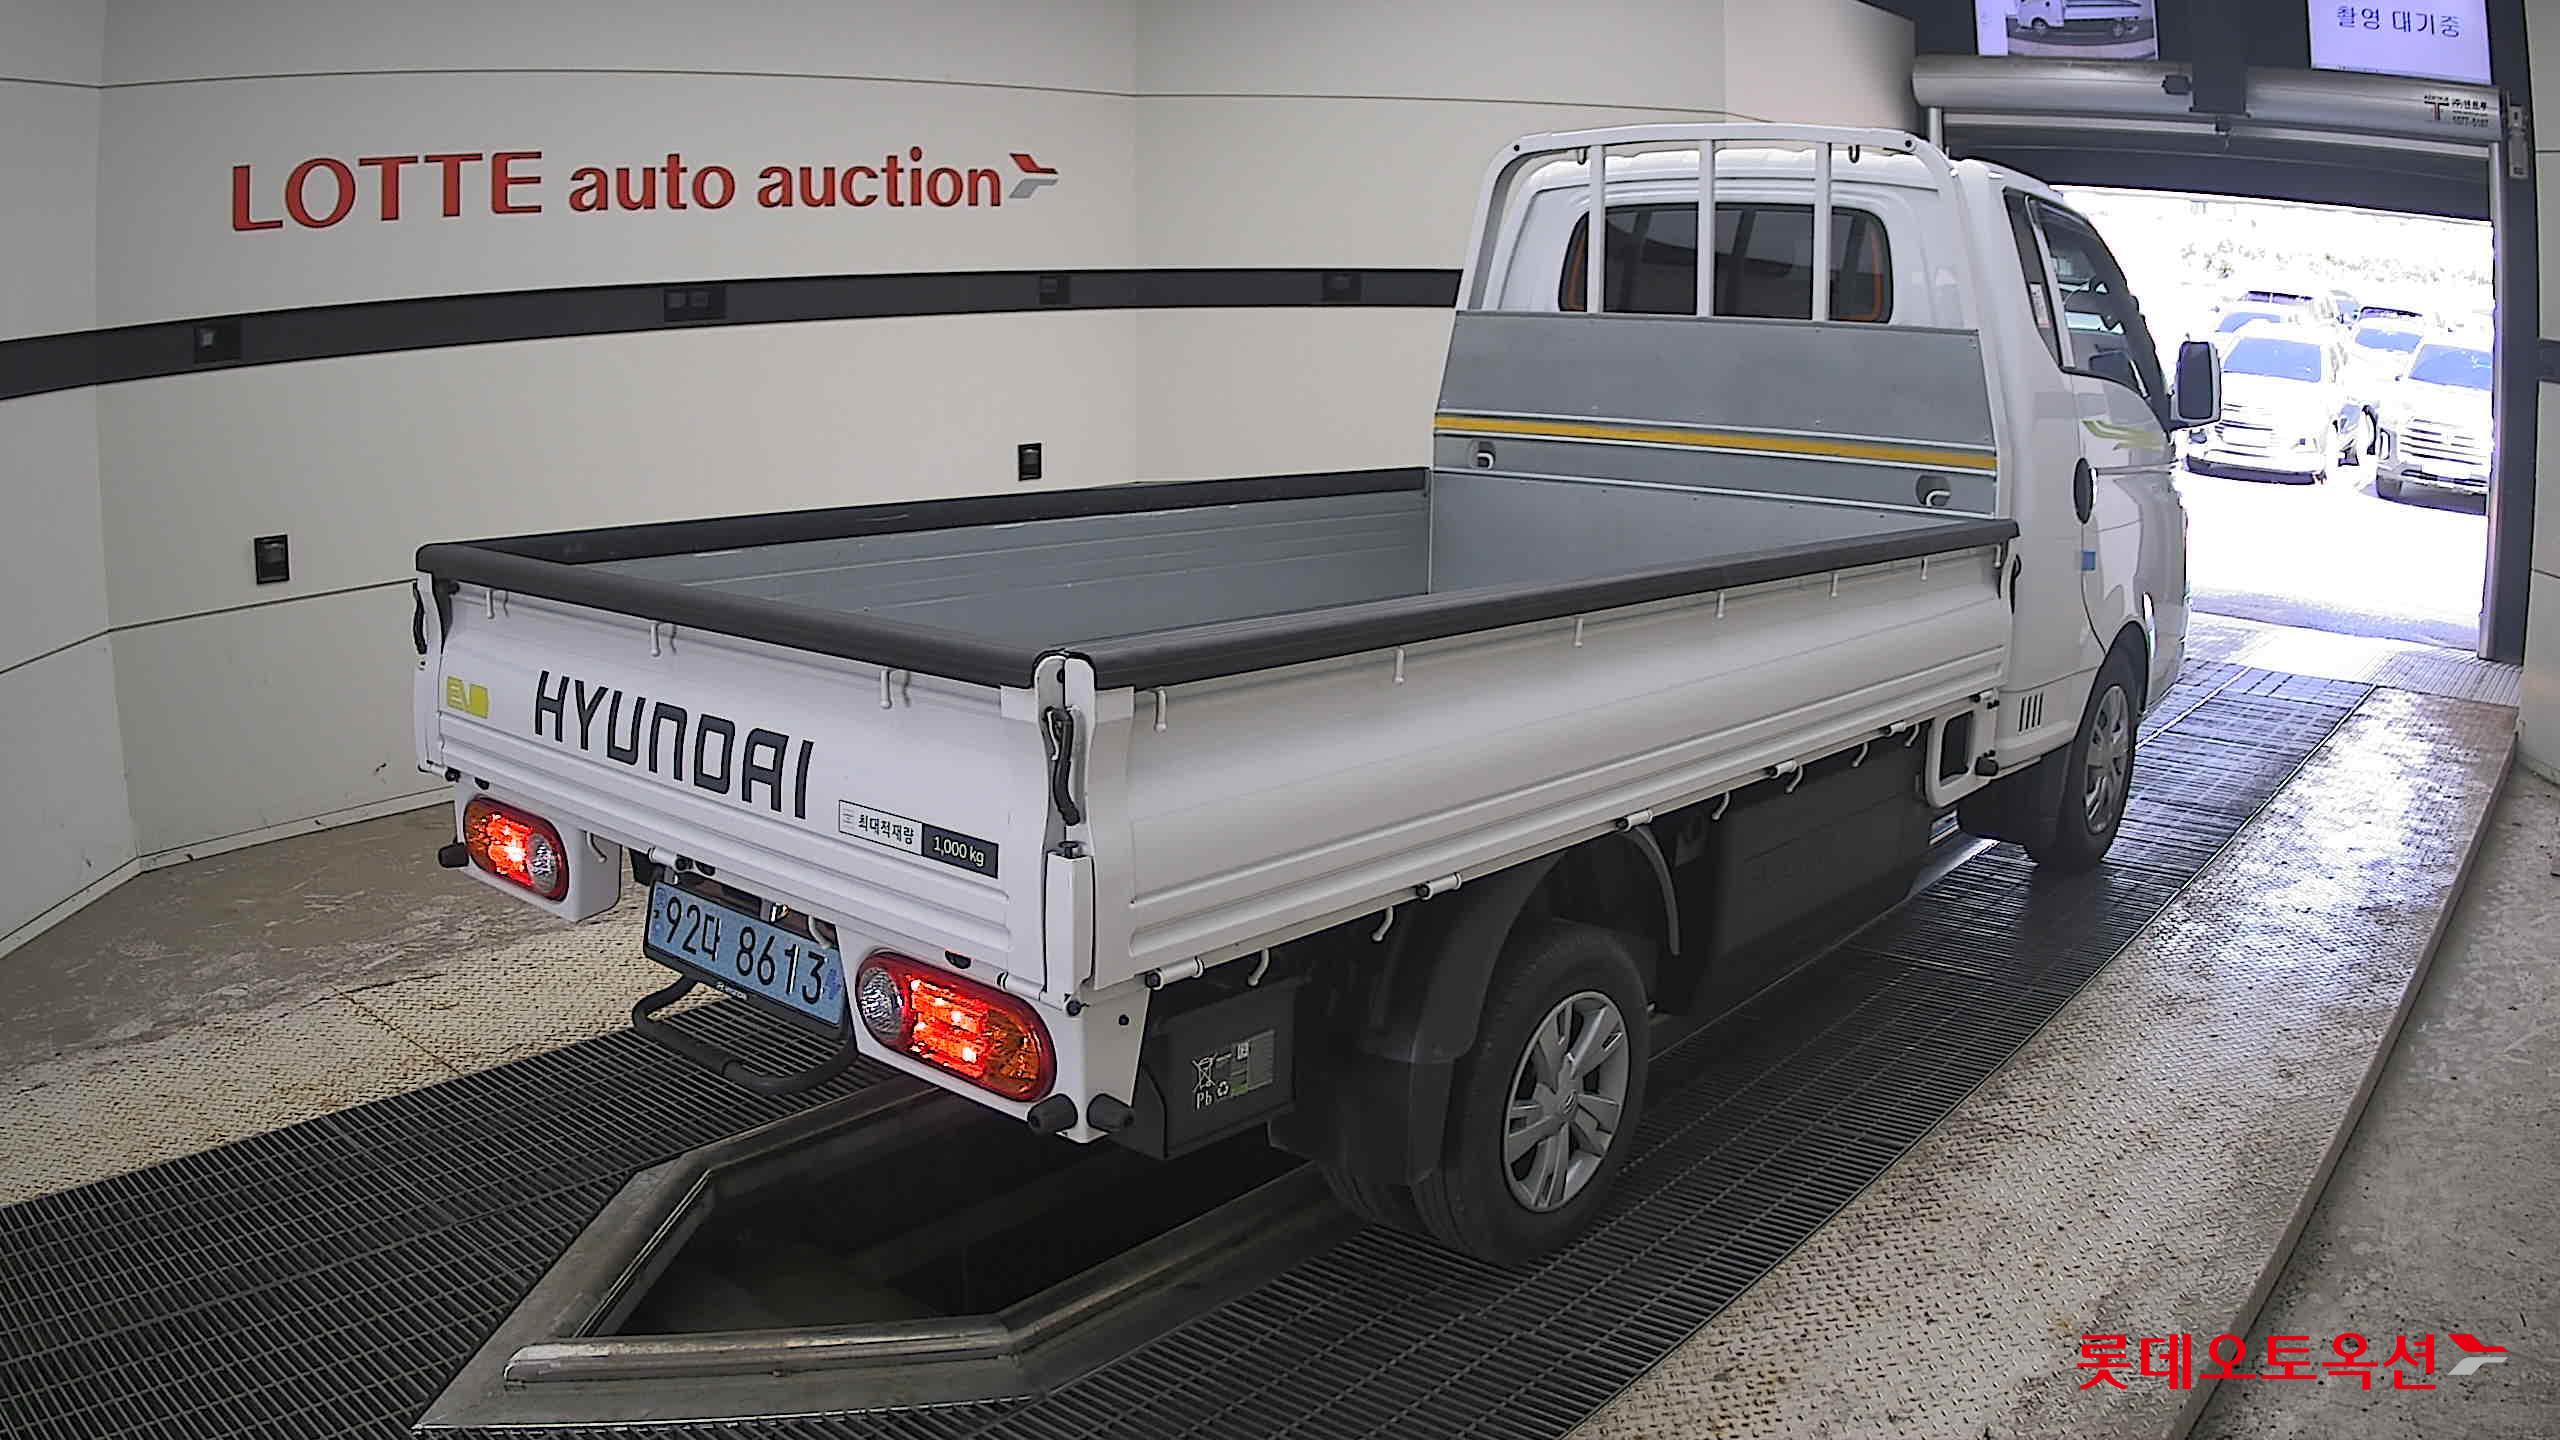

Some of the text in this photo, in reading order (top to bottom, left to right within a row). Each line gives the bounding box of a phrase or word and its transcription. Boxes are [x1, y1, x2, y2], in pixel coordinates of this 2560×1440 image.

[2337, 6, 2461, 38] 촬영 대기중
[232, 146, 1002, 232] LOTTE auto auction
[534, 669, 814, 820] HYUNDAI
[857, 814, 915, 845] 최대적재량
[933, 836, 967, 859] 1,000
[969, 846, 985, 867] kg
[736, 926, 826, 1005] 8613
[1196, 1091, 1213, 1111] Pb
